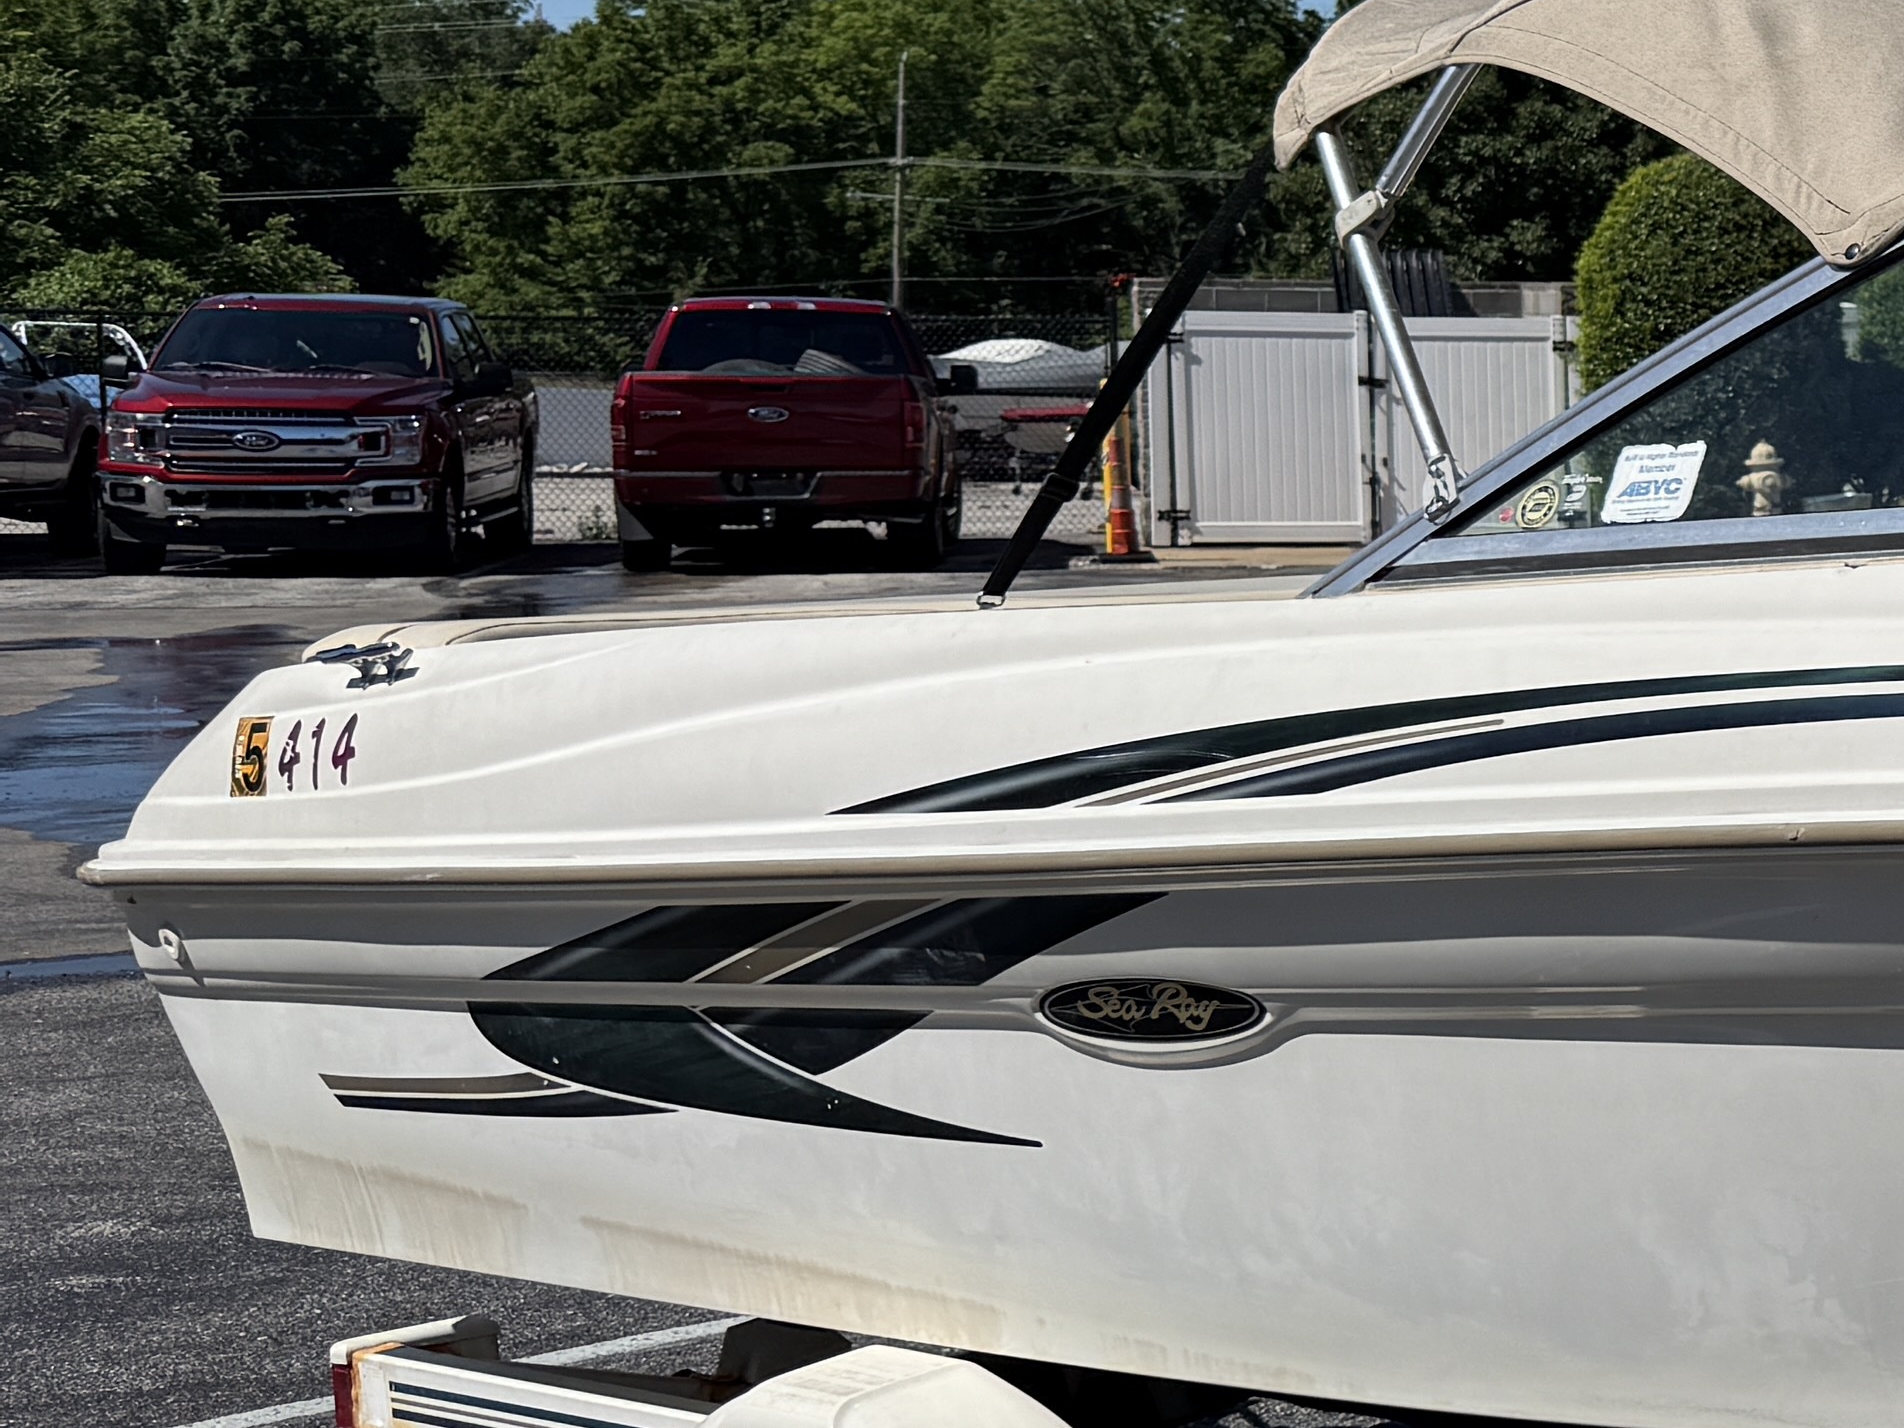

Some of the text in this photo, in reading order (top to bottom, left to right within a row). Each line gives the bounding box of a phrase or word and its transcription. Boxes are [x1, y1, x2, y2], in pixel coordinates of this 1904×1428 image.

[1616, 477, 1684, 498] ABYC
[241, 722, 268, 792] 5
[278, 713, 358, 791] 414
[1077, 981, 1221, 1031] Sea Ray
